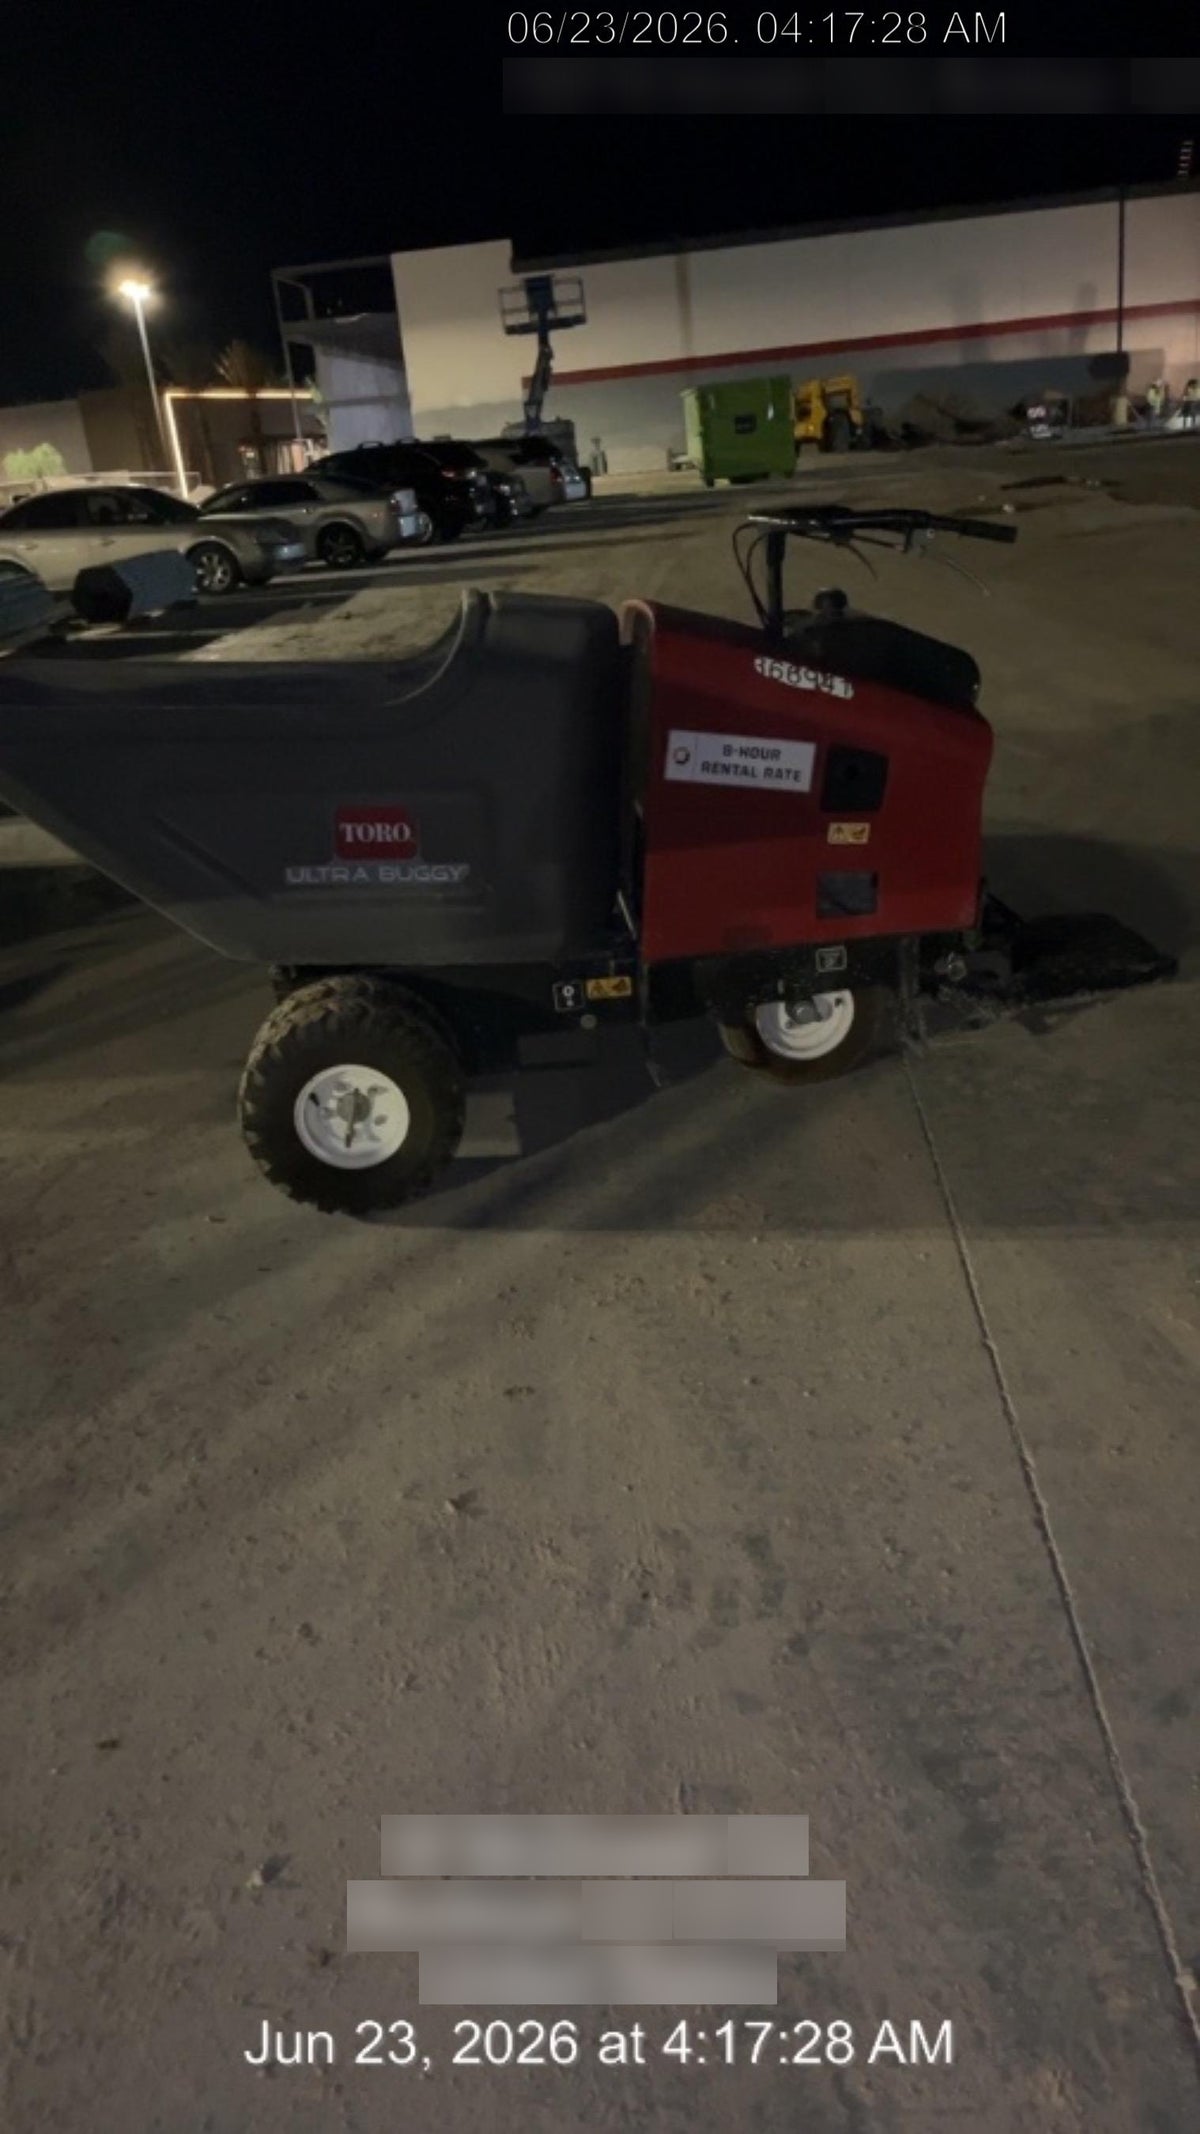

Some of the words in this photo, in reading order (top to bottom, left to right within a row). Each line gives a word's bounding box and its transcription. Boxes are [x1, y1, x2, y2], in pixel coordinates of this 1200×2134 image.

[721, 743, 782, 762] 8-HOUR
[700, 760, 758, 779] RENTAL
[763, 766, 802, 783] RATE
[339, 822, 411, 843] TORO
[284, 865, 371, 884] ULTRA
[377, 863, 467, 883] BUGGY
